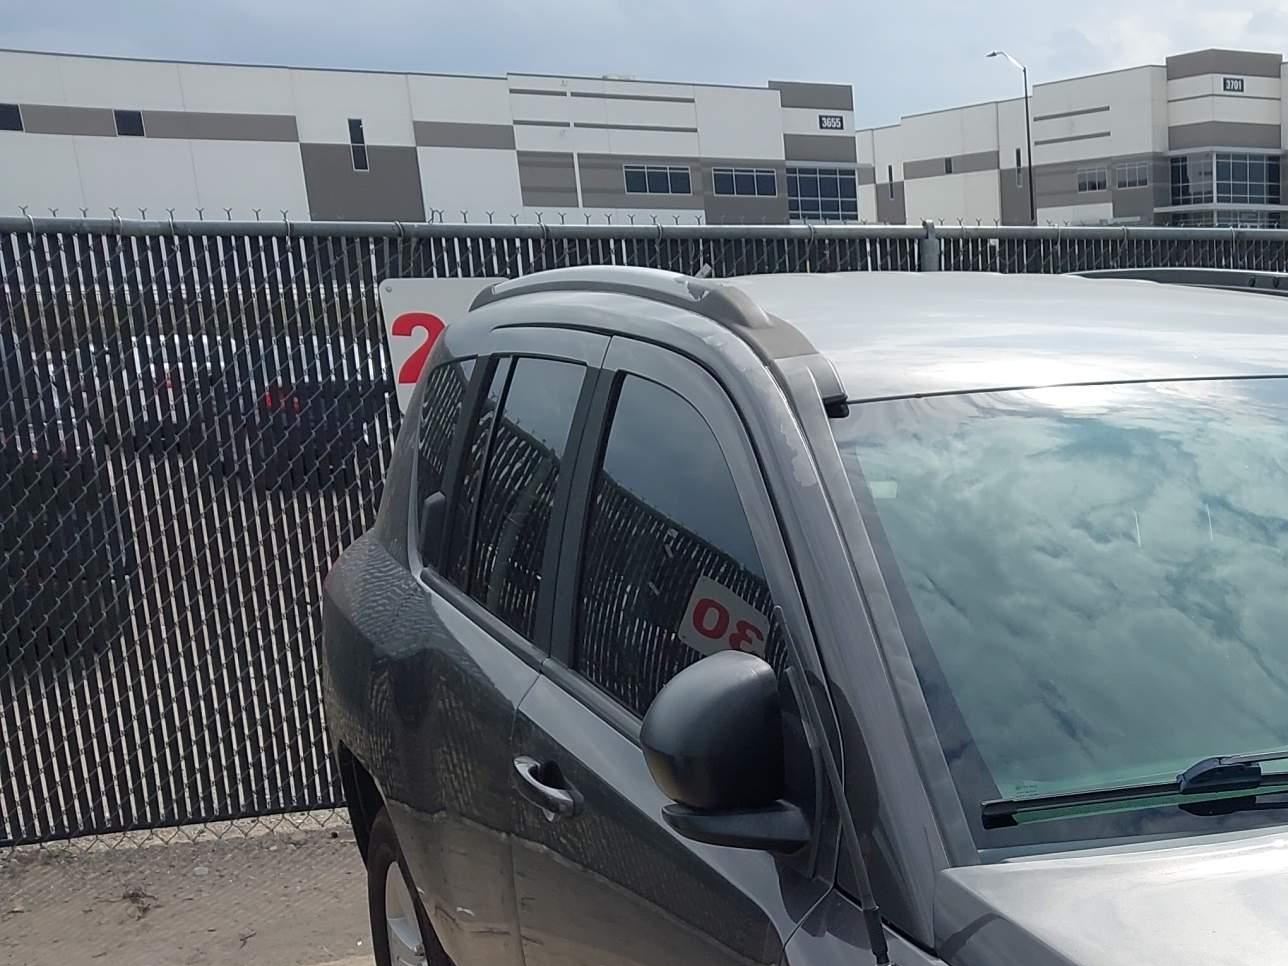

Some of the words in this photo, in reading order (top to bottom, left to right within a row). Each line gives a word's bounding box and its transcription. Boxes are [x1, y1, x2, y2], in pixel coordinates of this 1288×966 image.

[1225, 79, 1242, 90] 3701
[821, 116, 842, 128] 3655
[391, 312, 446, 384] 2
